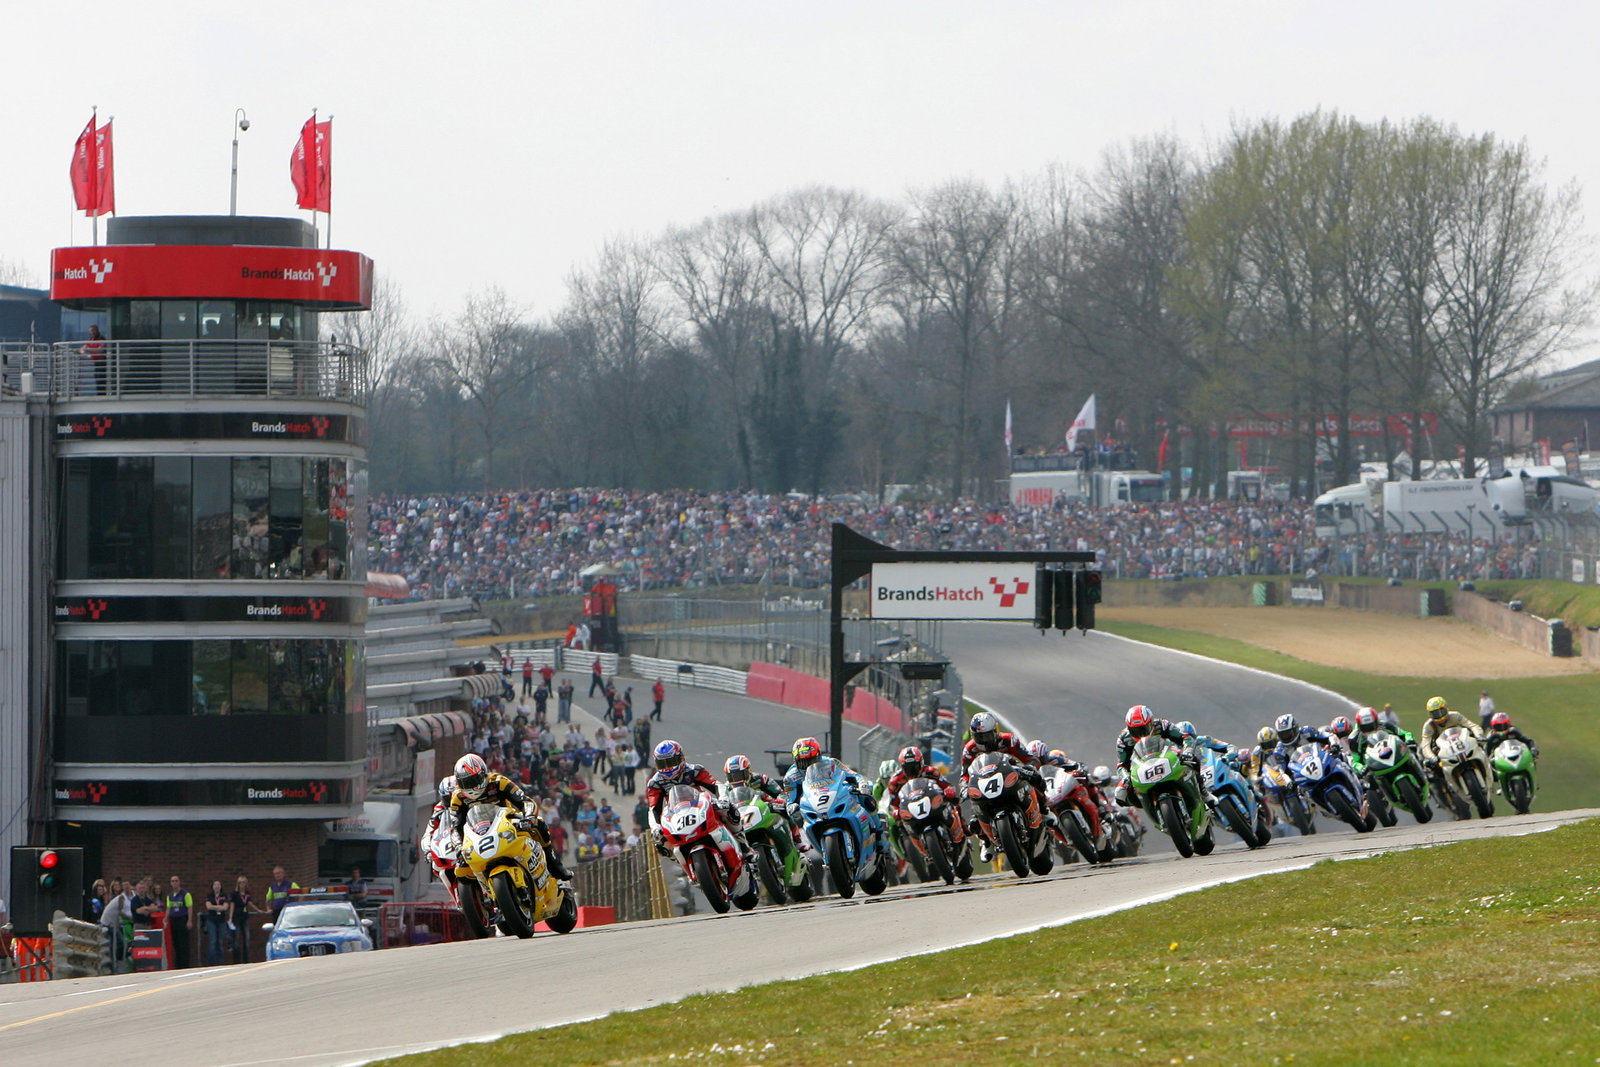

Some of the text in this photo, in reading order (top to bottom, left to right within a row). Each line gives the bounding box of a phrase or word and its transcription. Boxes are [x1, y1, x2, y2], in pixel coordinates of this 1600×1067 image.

[241, 266, 314, 280] BrandsHatch
[252, 421, 311, 432] BrandsHatch
[878, 586, 984, 601] BrandsHatch
[247, 604, 307, 615] BrandsHatch
[1306, 762, 1318, 775] 12
[984, 778, 1000, 794] 4
[247, 788, 307, 799] BrandsHatch
[817, 795, 830, 807] 9
[917, 802, 927, 817] 1
[676, 814, 697, 832] 36
[479, 836, 495, 855] 2
